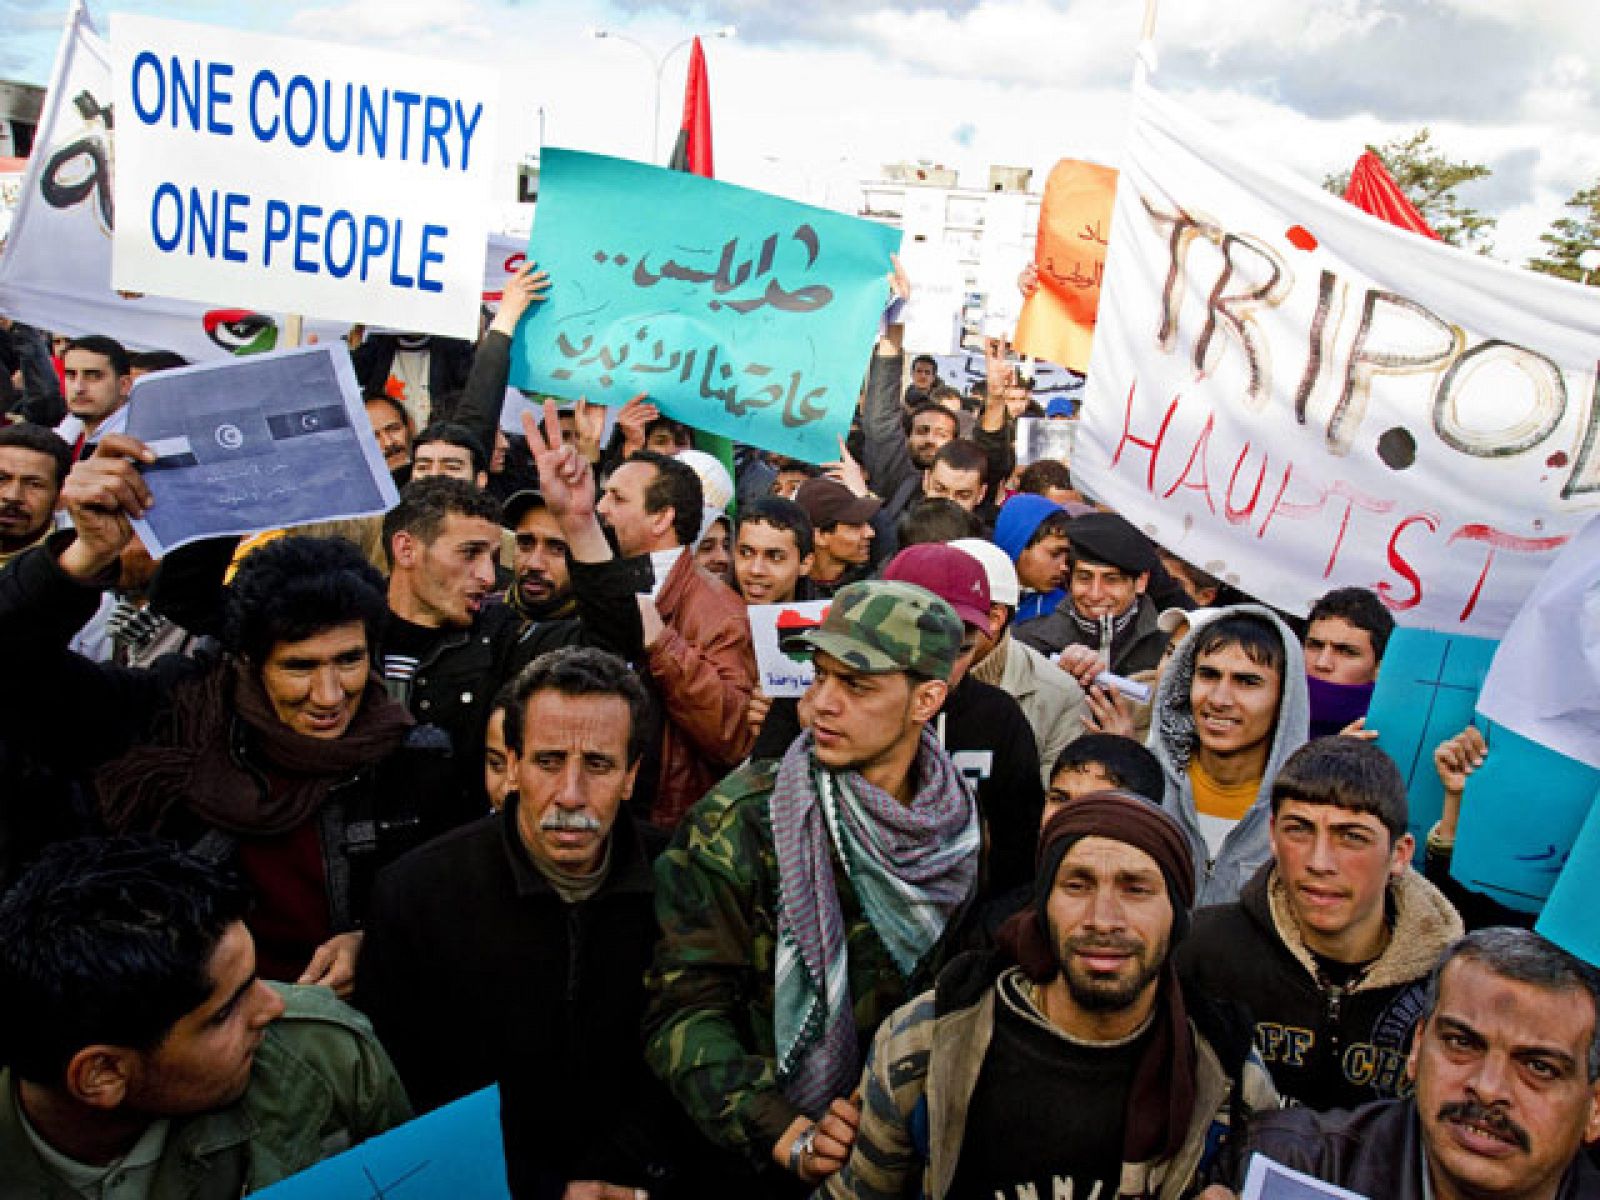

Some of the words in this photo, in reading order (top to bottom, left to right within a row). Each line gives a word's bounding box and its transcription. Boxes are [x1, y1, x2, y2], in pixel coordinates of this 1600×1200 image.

[131, 50, 234, 135] ONE
[249, 69, 483, 172] COUNTRY
[151, 182, 251, 259] ONE
[263, 199, 449, 292] PEOPLE
